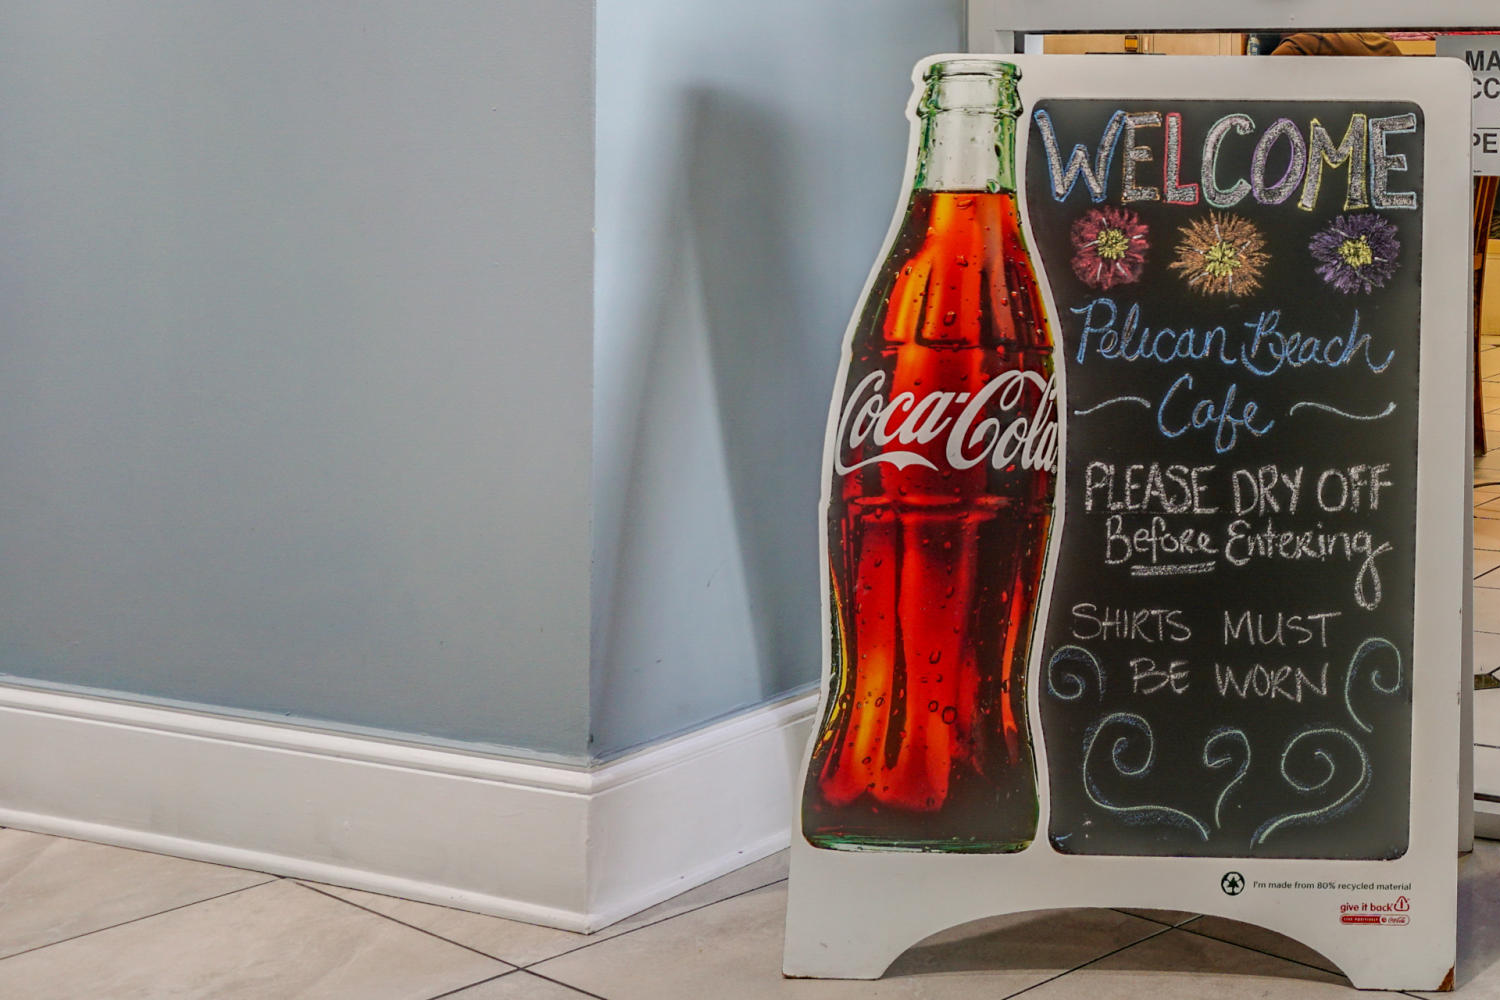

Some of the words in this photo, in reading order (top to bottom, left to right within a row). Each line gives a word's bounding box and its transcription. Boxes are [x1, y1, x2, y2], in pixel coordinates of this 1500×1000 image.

[1034, 109, 1417, 210] WELCOME
[1070, 297, 1238, 364] Pelican
[1241, 309, 1395, 377] Beach
[835, 369, 1058, 476] Coca-Cola
[1158, 373, 1275, 454] Cafe
[1084, 460, 1219, 514] PLEASE
[1231, 465, 1304, 516] DRY
[1317, 463, 1393, 512] OFF
[1105, 514, 1219, 565] Before
[1224, 519, 1395, 610] Entering
[1072, 603, 1191, 643] SHIRTS
[1224, 609, 1342, 648] MUST
[1129, 657, 1190, 695] BE
[1215, 661, 1329, 703] WORN
[1253, 881, 1267, 889] I'm
[1268, 881, 1292, 889] made
[1294, 881, 1315, 889] from
[1337, 882, 1375, 891] recycled
[1376, 882, 1412, 891] material
[1340, 902, 1359, 913] give
[1361, 902, 1368, 911] it
[1370, 902, 1393, 911] back
